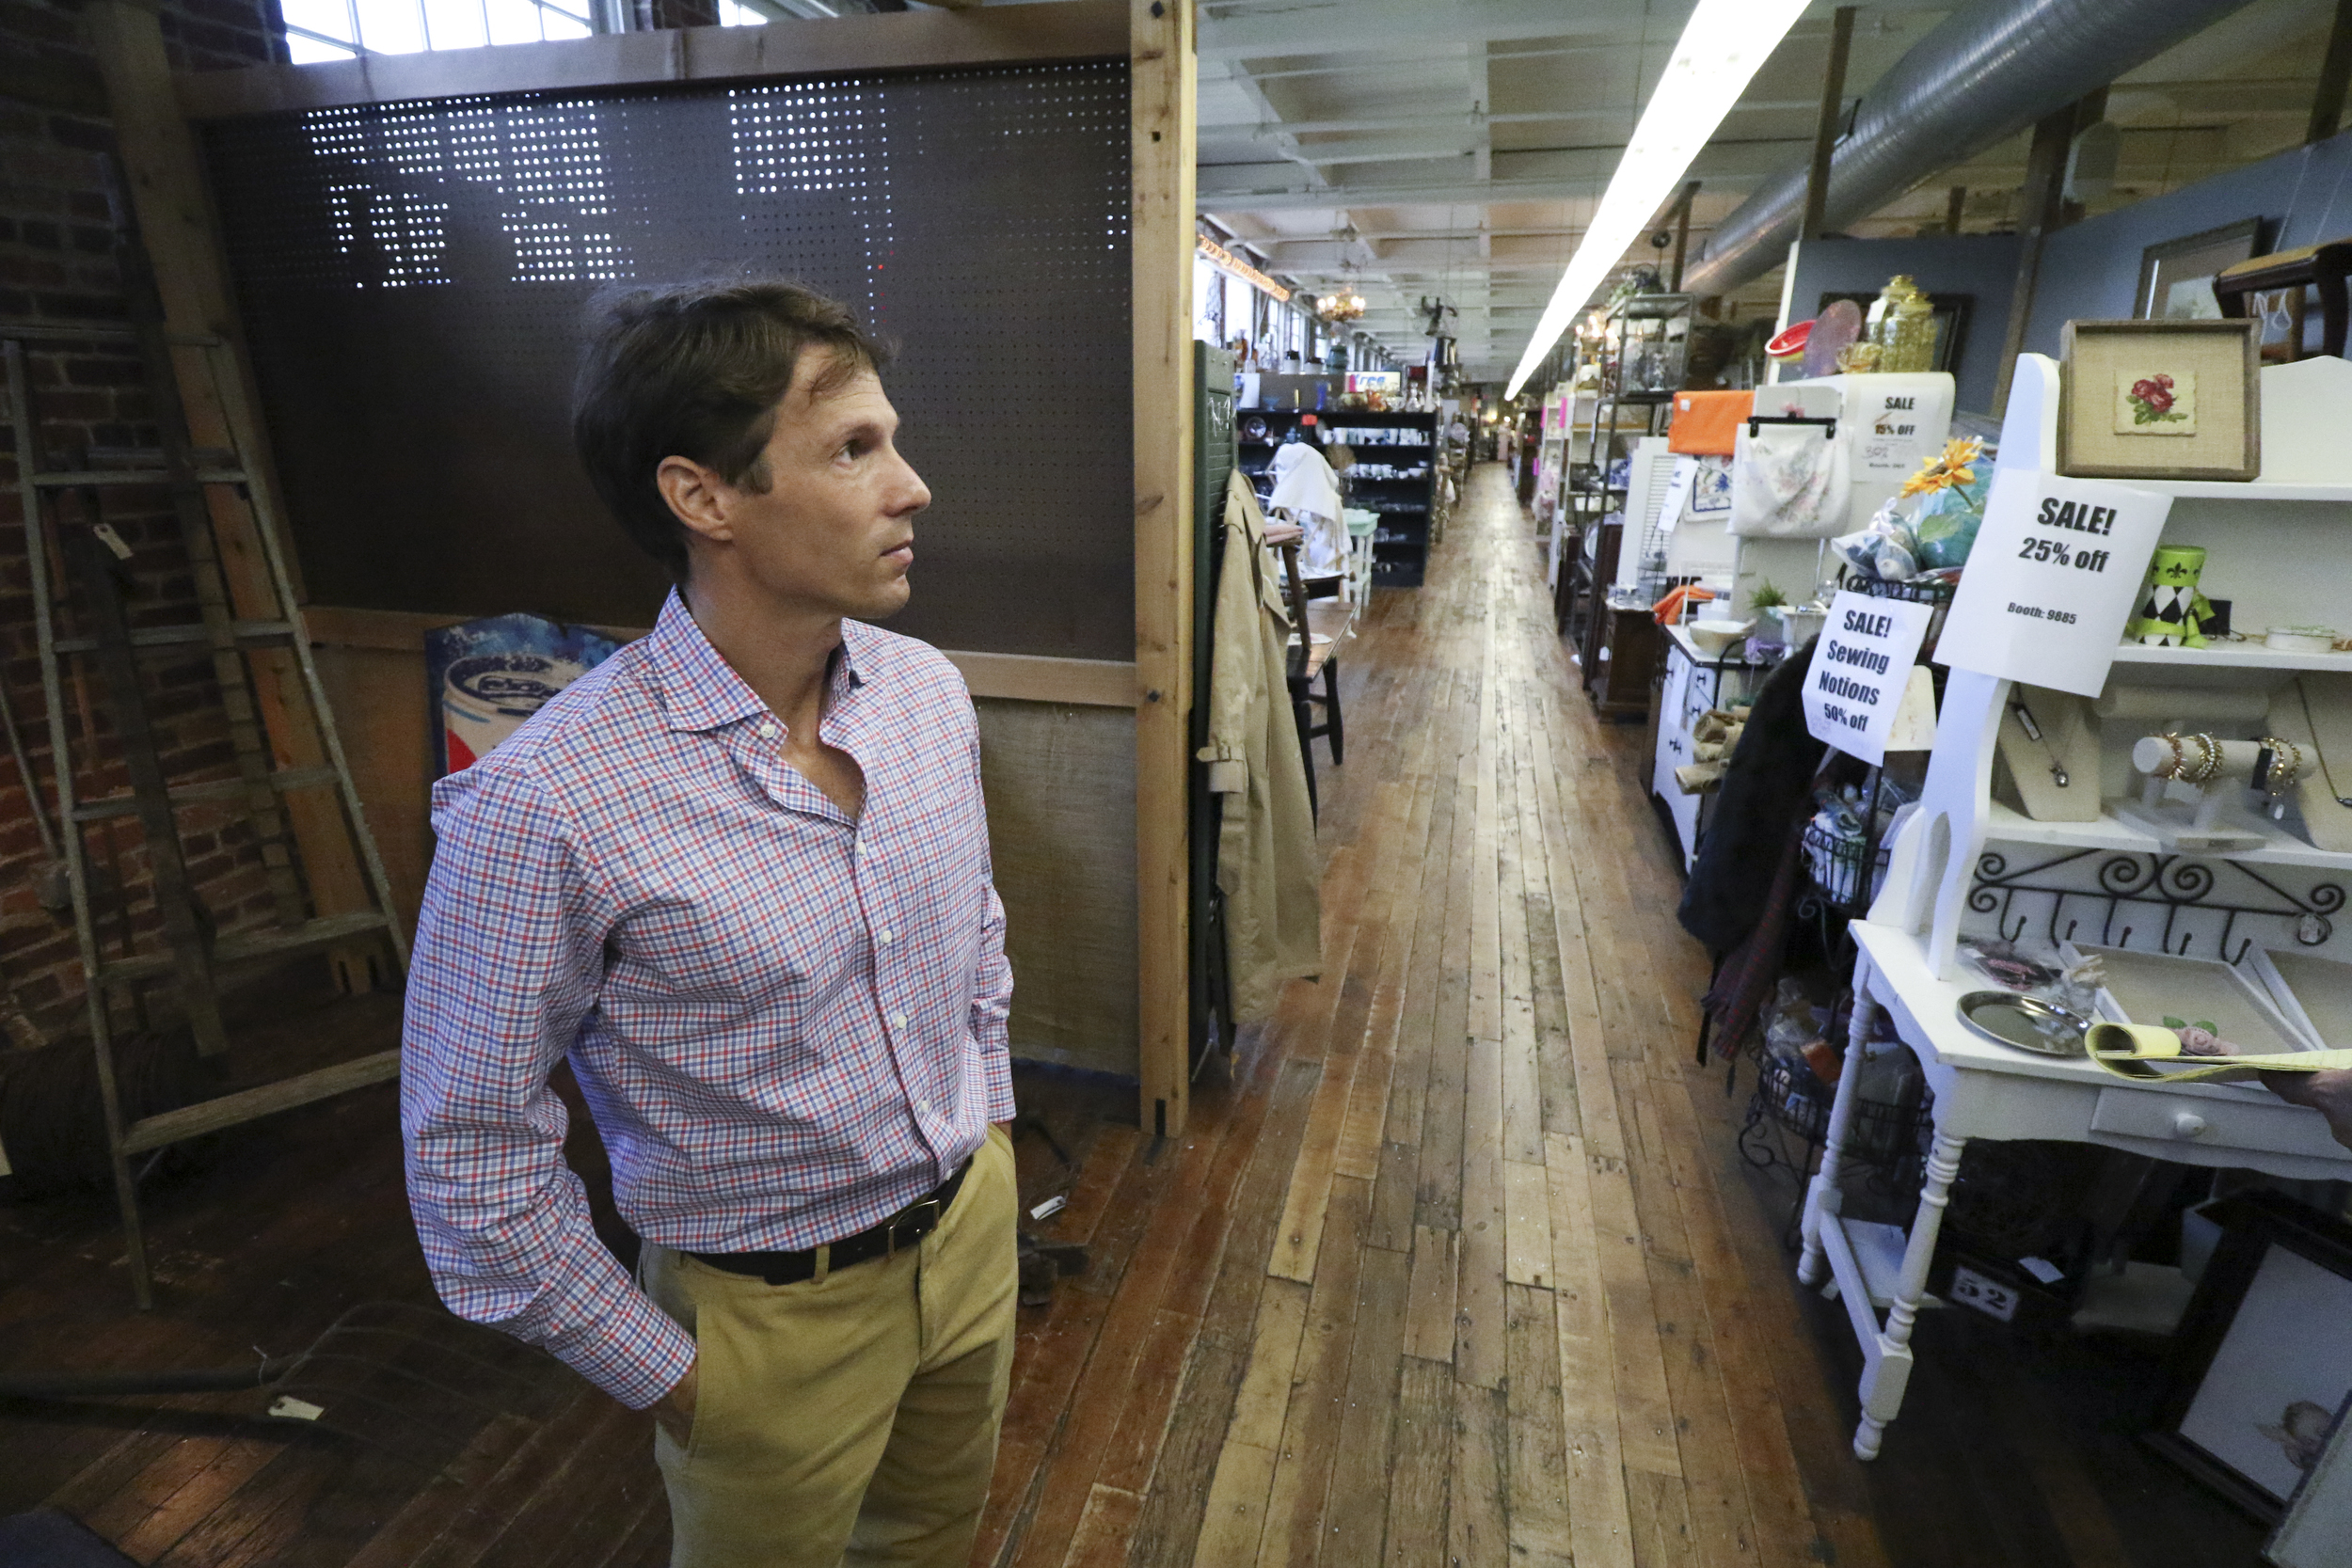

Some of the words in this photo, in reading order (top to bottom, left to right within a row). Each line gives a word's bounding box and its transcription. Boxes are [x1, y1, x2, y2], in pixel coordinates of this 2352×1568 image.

[1885, 397, 1915, 410] SALE
[1897, 424, 1915, 436] OFF
[2037, 497, 2118, 536] SALE!
[2018, 537, 2071, 566] 25%
[2074, 549, 2110, 573] off
[1843, 610, 1893, 639] SALE!
[2007, 602, 2045, 619] Booth:
[2046, 609, 2077, 625] 9885
[1827, 640, 1890, 675] Sewing
[1819, 670, 1881, 705] Notions
[1824, 703, 1848, 726] 50%
[1850, 714, 1869, 732] off
[1958, 1278, 2007, 1311] 52
